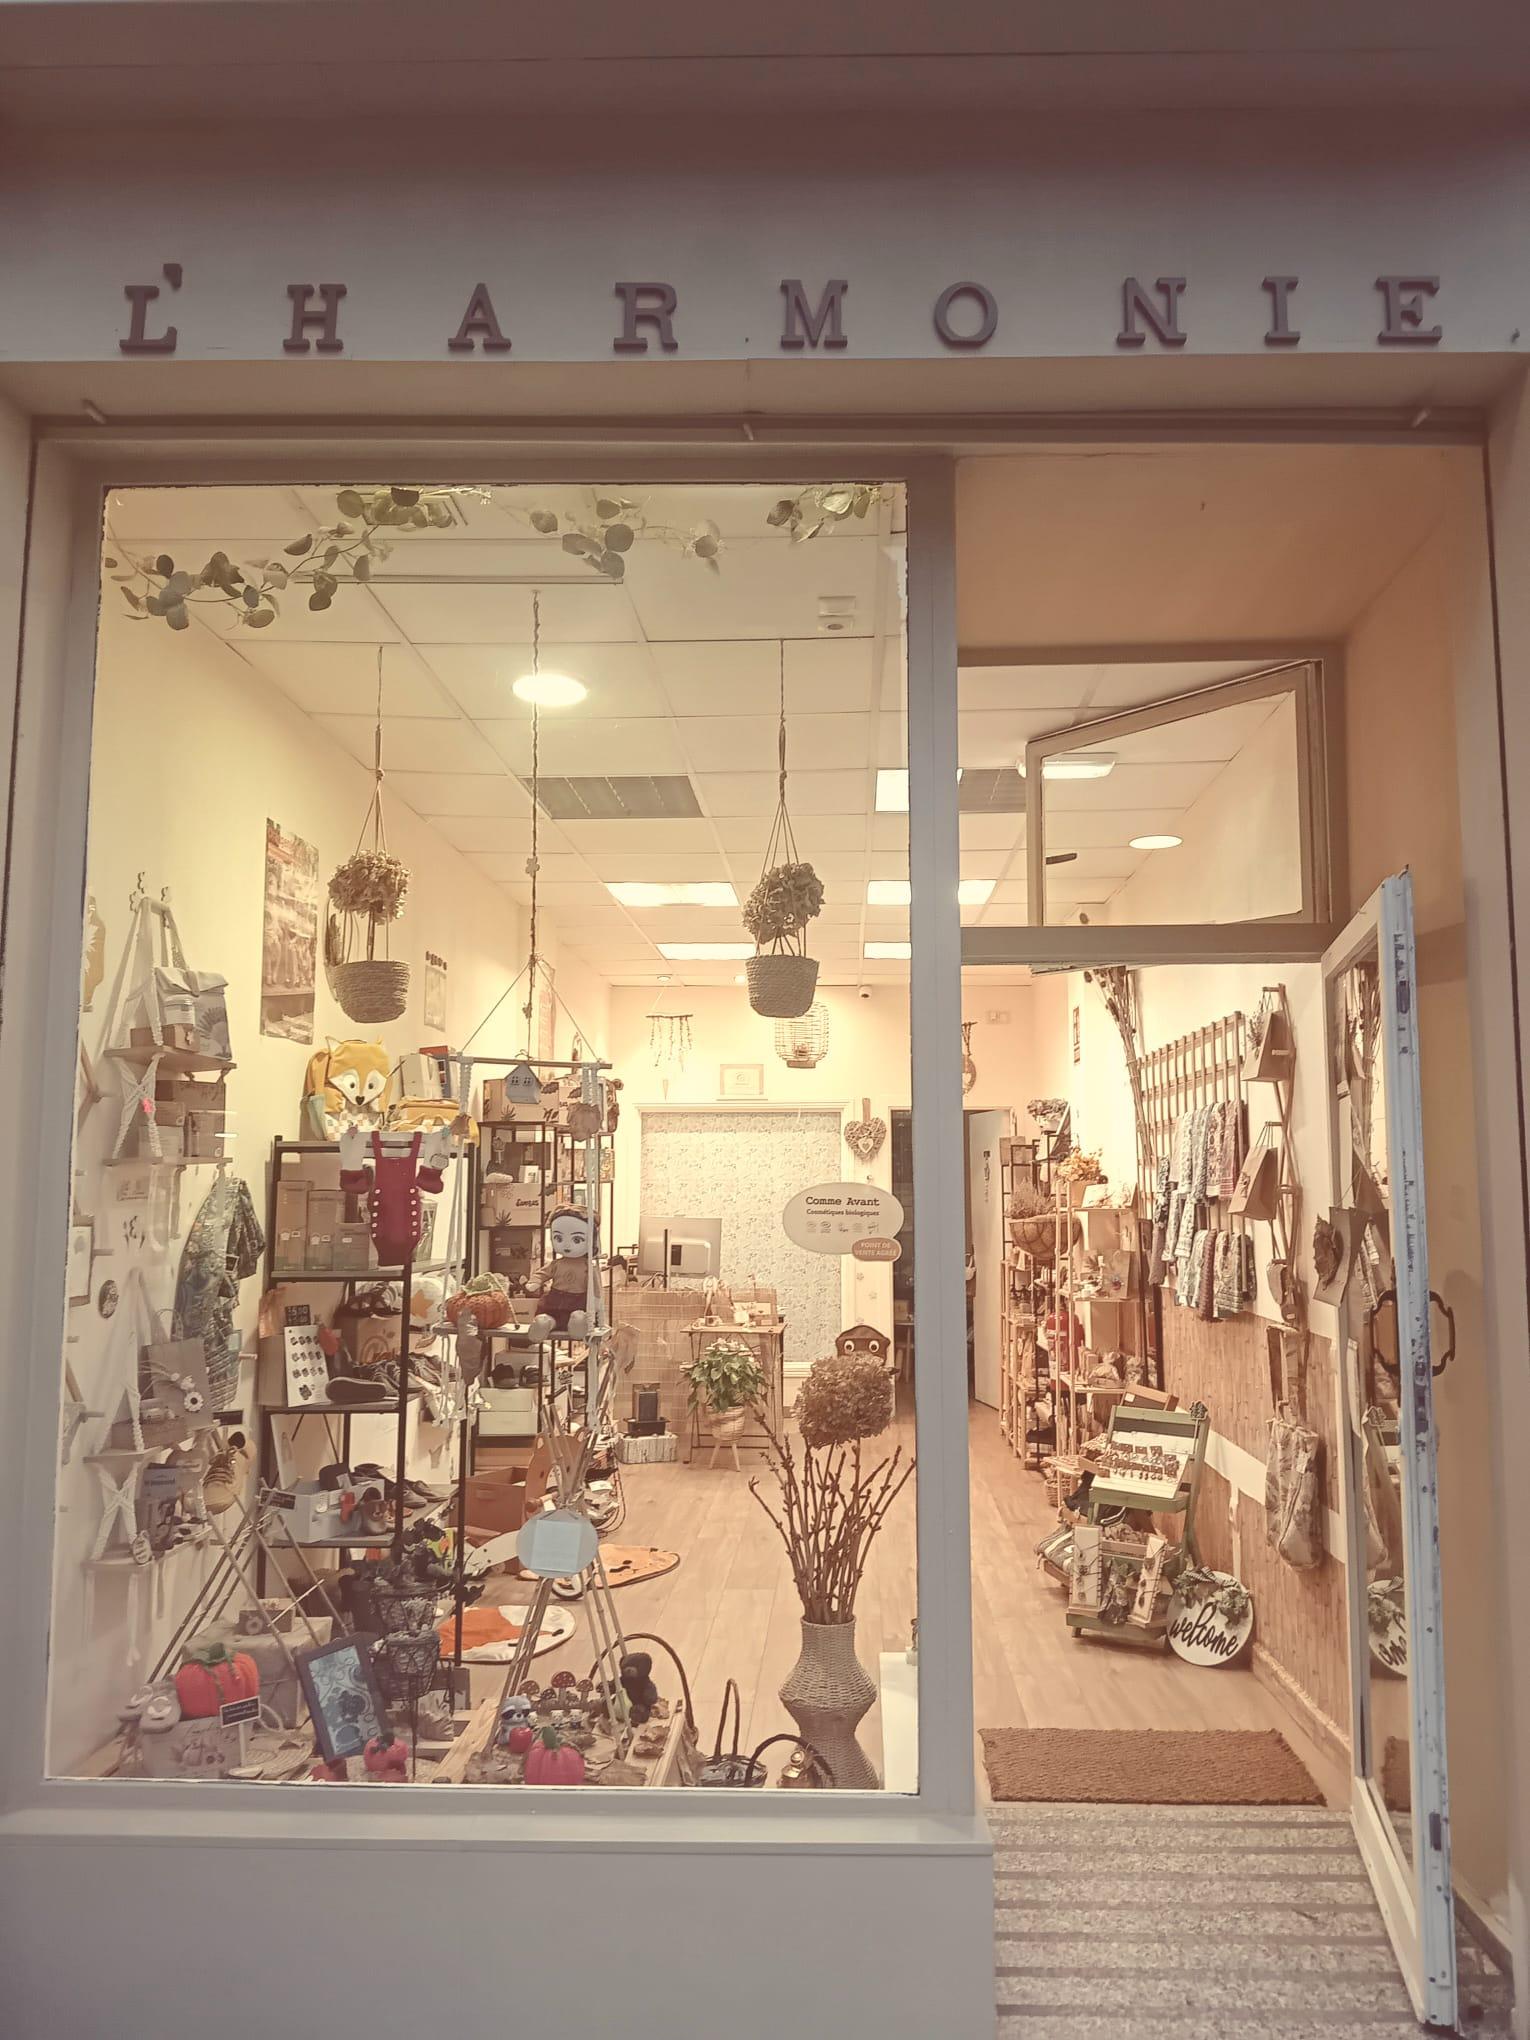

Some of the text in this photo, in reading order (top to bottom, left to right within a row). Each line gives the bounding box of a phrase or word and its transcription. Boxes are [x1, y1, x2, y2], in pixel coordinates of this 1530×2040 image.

[119, 262, 1443, 352] L'HARMONIE
[805, 1196, 880, 1206] Comme Avant
[806, 1208, 880, 1217] Cosmétiques biologiques
[1169, 1602, 1239, 1656] welcome
